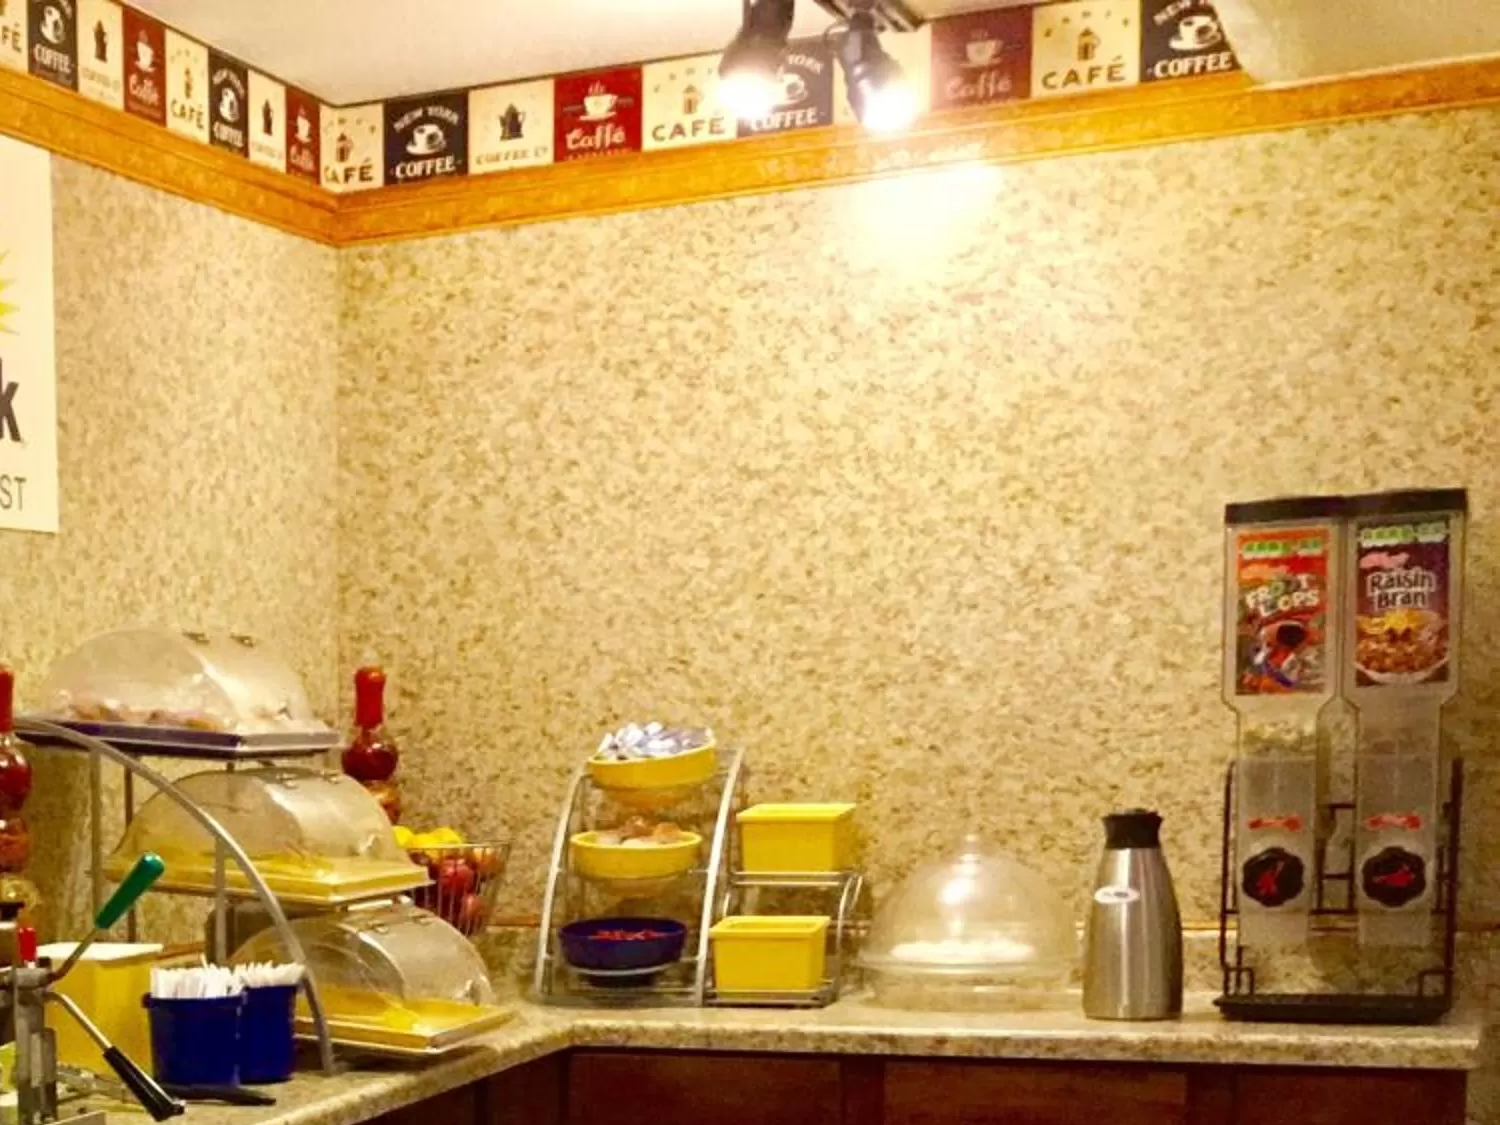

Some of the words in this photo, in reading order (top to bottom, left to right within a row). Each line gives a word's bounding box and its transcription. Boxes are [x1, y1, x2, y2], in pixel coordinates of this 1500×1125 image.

[33, 43, 72, 74] COFFEE
[1155, 52, 1232, 80] COFFEE
[1041, 55, 1127, 90] CAFÉ
[393, 107, 424, 133] NEW
[427, 105, 460, 126] YORK
[750, 107, 819, 133] COFFEE
[323, 157, 374, 184] CAFÉ
[395, 155, 456, 179] COFFEE
[1369, 568, 1435, 594] Raisin
[1376, 589, 1428, 610] Bran
